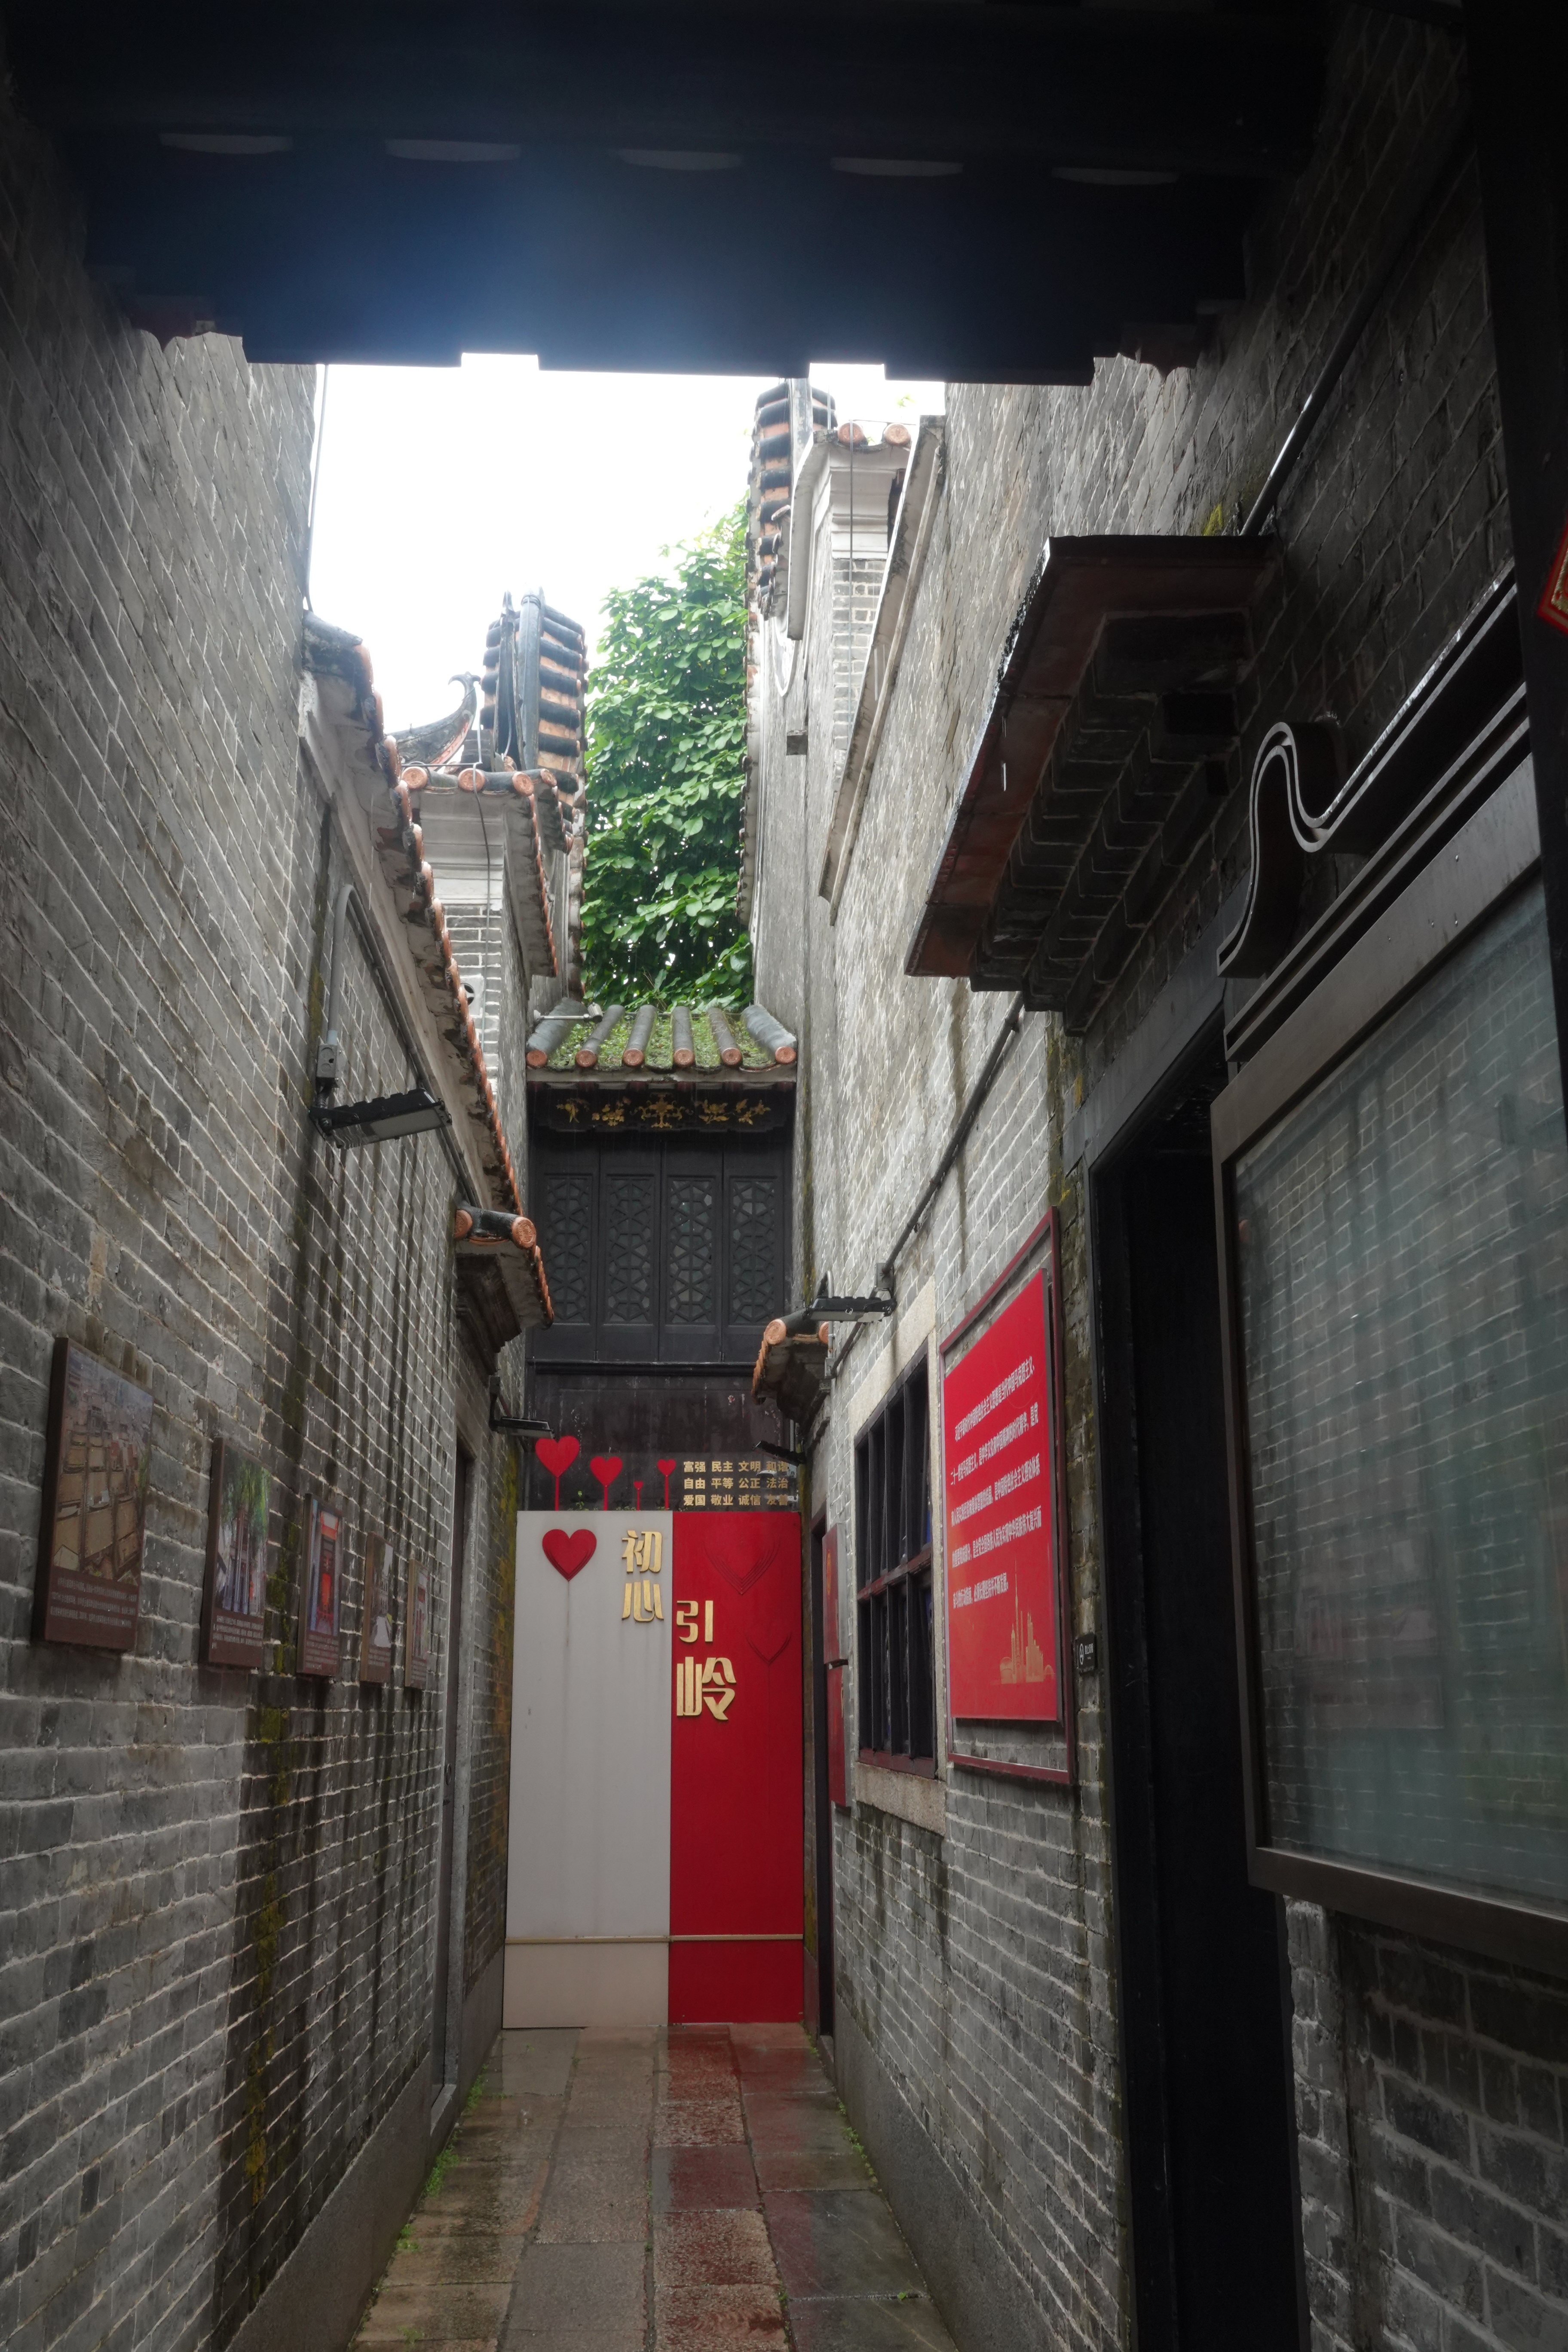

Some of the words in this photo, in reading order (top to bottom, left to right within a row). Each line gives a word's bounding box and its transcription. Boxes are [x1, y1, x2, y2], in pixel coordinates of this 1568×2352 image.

[683, 1461, 706, 1473] 富强
[711, 1461, 733, 1473] 民主
[738, 1461, 761, 1472] 文明
[766, 1461, 788, 1472] 和谐
[684, 1477, 705, 1489] 自由
[711, 1477, 734, 1489] 平等
[738, 1477, 760, 1489] 公正
[766, 1477, 788, 1489] 法治
[683, 1494, 706, 1506] 爱国
[710, 1494, 733, 1506] 敬业
[738, 1494, 761, 1506] 诚信
[767, 1494, 788, 1506] 友善
[622, 1530, 665, 1623] 初心
[676, 1600, 737, 1721] 引岭
